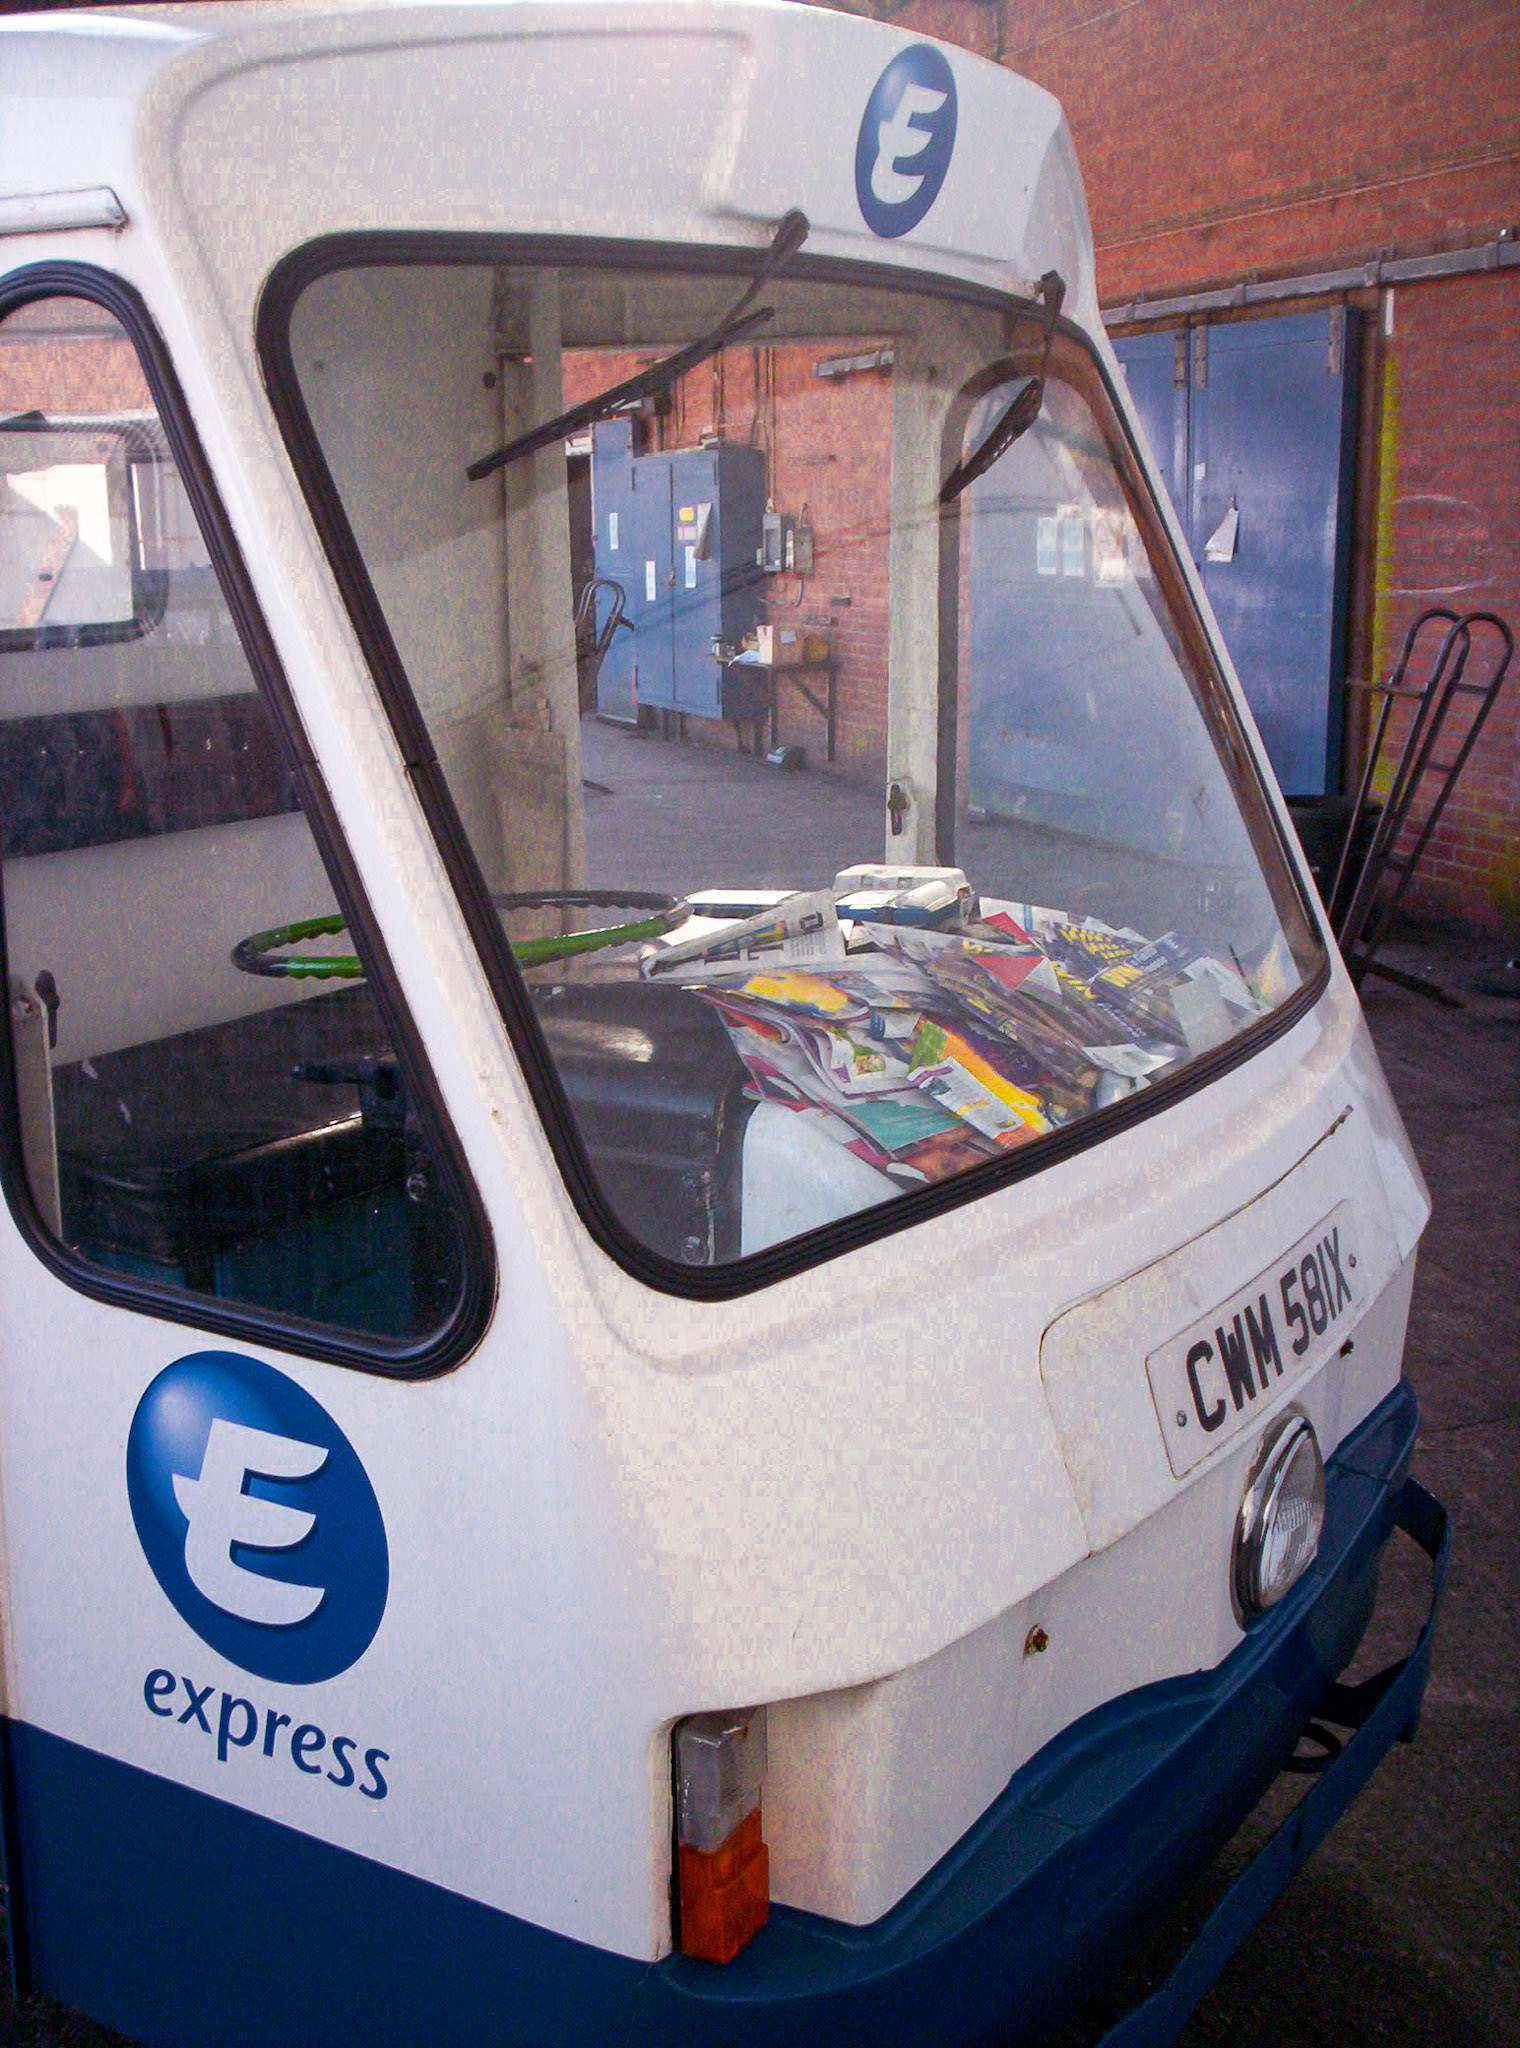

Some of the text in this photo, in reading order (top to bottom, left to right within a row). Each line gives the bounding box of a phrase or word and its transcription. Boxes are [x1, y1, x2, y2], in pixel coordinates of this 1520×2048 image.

[1186, 1227, 1352, 1433] CWM 581X
[144, 1668, 391, 1800] express
